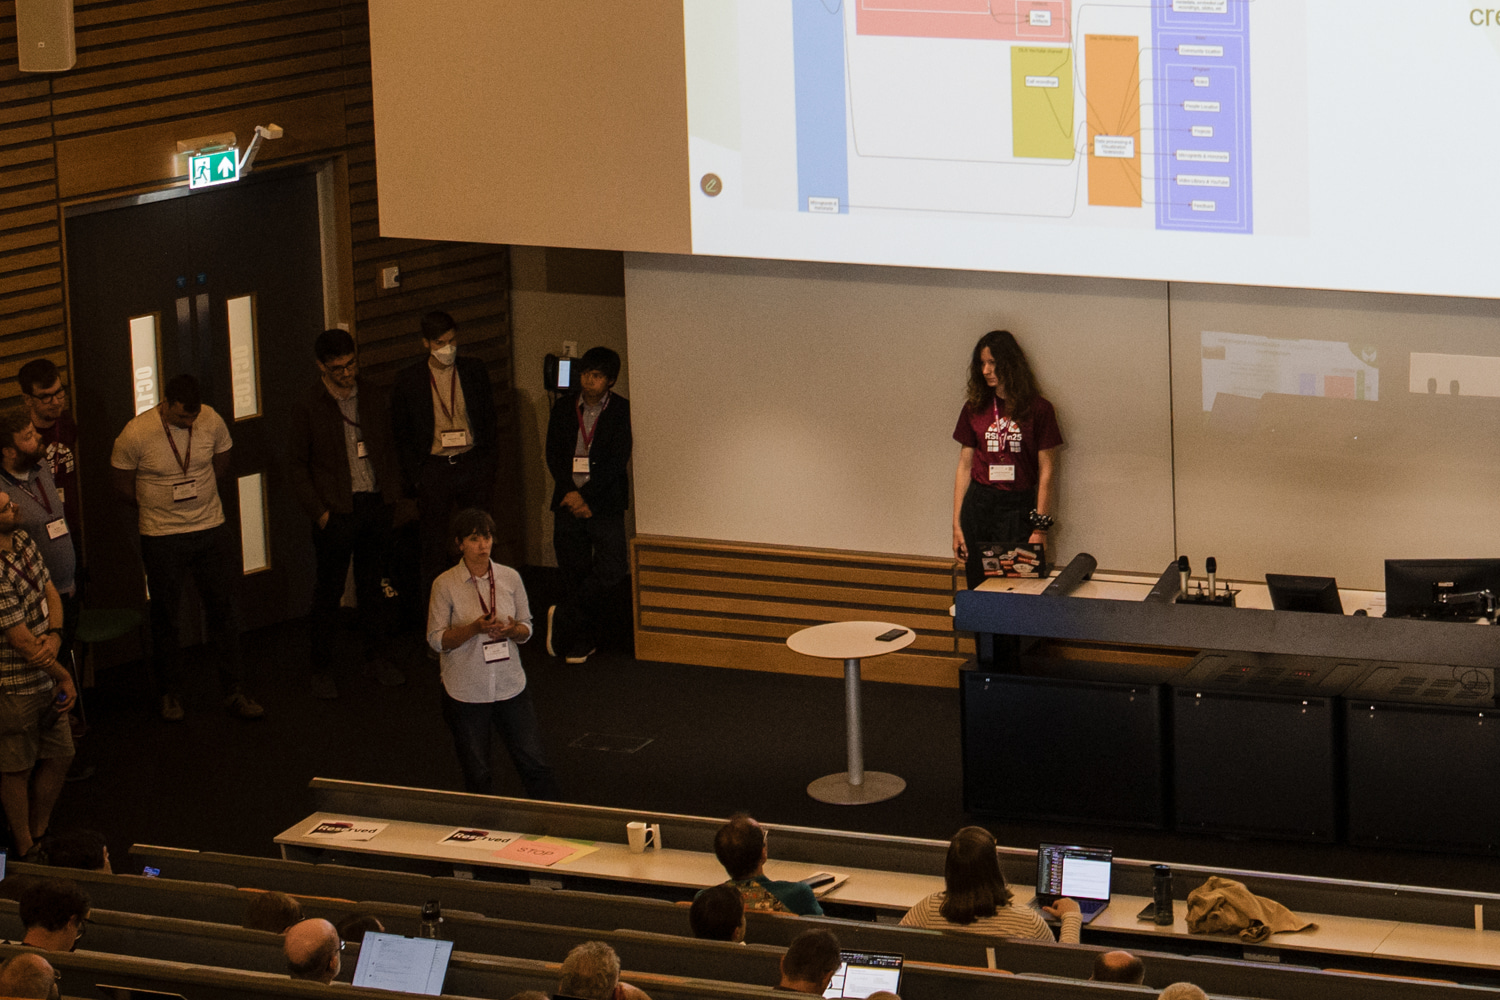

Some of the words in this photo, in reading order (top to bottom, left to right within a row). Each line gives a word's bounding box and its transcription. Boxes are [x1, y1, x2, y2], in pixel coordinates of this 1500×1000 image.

[319, 824, 379, 834] Reserved
[454, 832, 512, 844] Reserved
[516, 846, 555, 858] STOP
